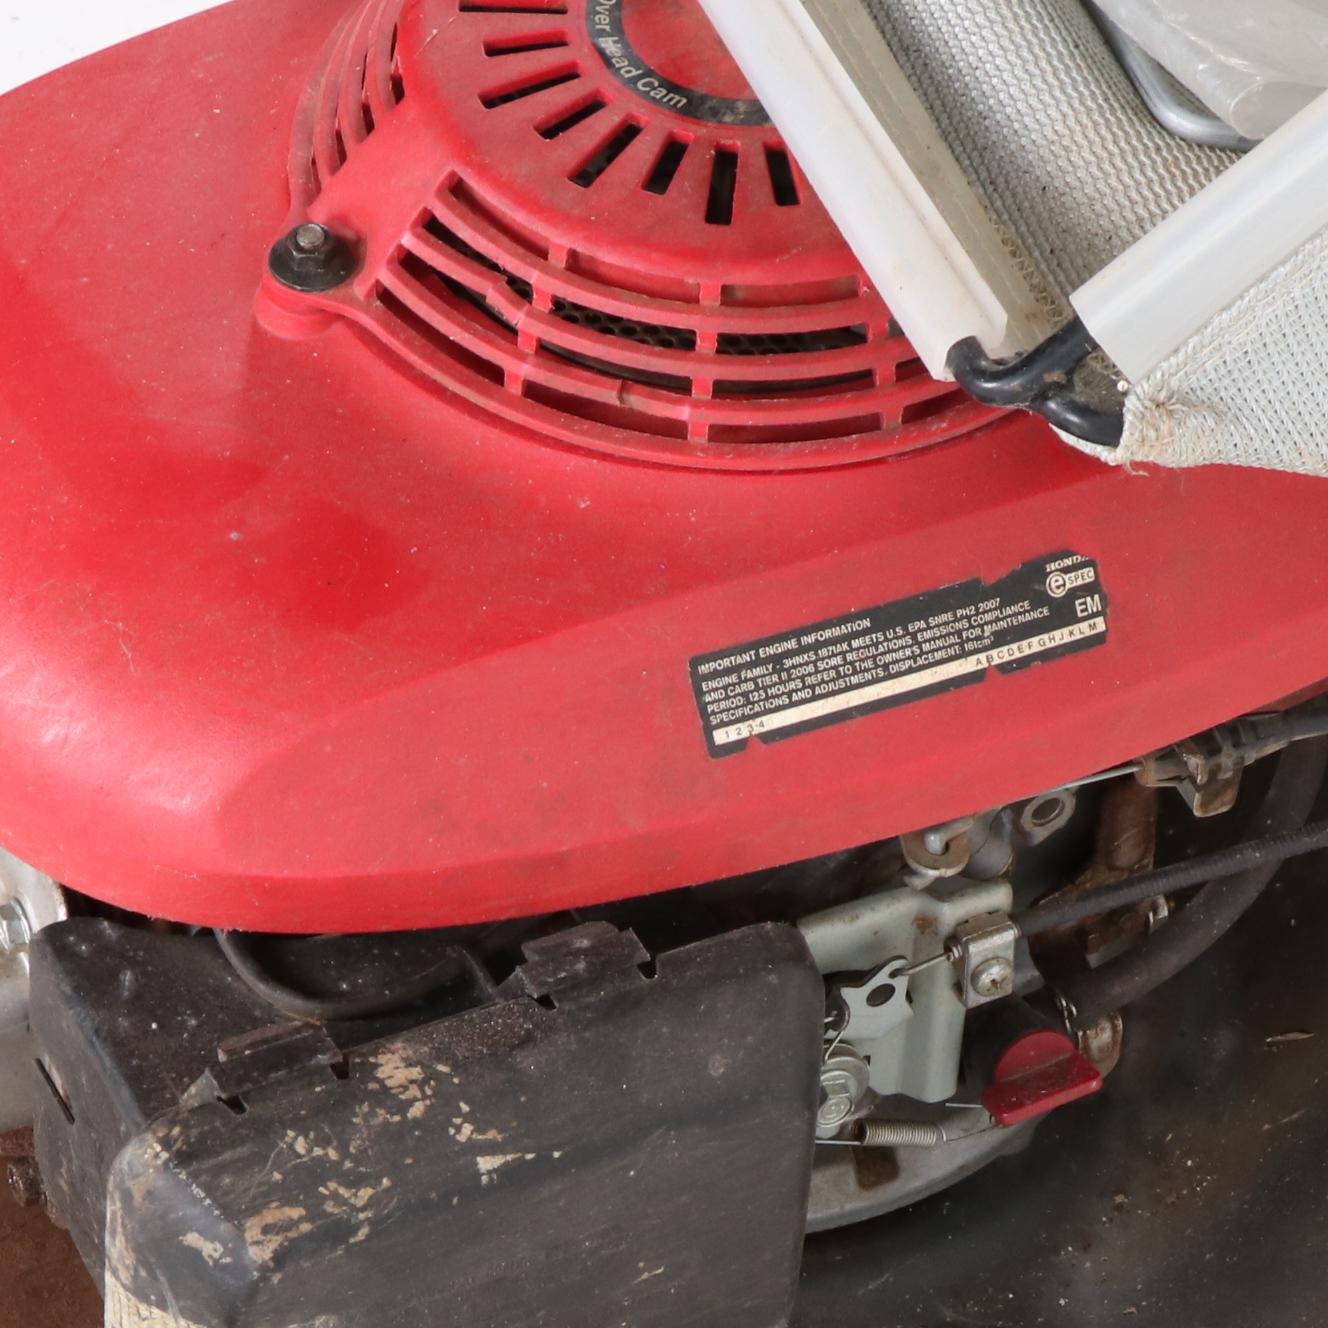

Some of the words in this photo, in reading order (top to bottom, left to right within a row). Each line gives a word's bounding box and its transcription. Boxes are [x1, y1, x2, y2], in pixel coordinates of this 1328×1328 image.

[598, 36, 643, 78] Head
[636, 77, 688, 108] Cam
[1067, 569, 1094, 586] SPEC
[1075, 594, 1102, 618] EM
[697, 650, 756, 675] IMPORTANT
[758, 638, 799, 658] ENGINE
[800, 617, 871, 646] INFORMATION
[701, 673, 739, 692] ENGINE
[740, 663, 773, 681] FAMILY
[851, 631, 885, 649] MEETS
[907, 620, 927, 633] EPA
[928, 611, 955, 627] SNRE
[956, 605, 976, 618] PH2
[977, 597, 1000, 613] 2007
[704, 689, 726, 703] AND
[727, 680, 755, 697] CARB
[756, 673, 780, 688] TIER
[789, 663, 815, 679] 2006
[816, 654, 844, 671] SORE
[916, 618, 970, 642] EMISSIONS
[970, 600, 1031, 626] COMPLIANCE
[706, 695, 747, 714] PERIOD:
[748, 689, 766, 702] 125
[767, 678, 803, 697] HOURS
[804, 669, 837, 686] REFER
[837, 664, 853, 676] TO
[854, 658, 875, 672] THE
[876, 644, 921, 666] OWNER'S
[921, 634, 962, 652] MANUAL
[961, 627, 983, 641] FOR
[983, 606, 1050, 635] MAINTENANCE
[709, 694, 790, 726] SPECIFICATIONS
[791, 688, 813, 702] AND
[888, 644, 962, 674] DISPLACEMENT:
